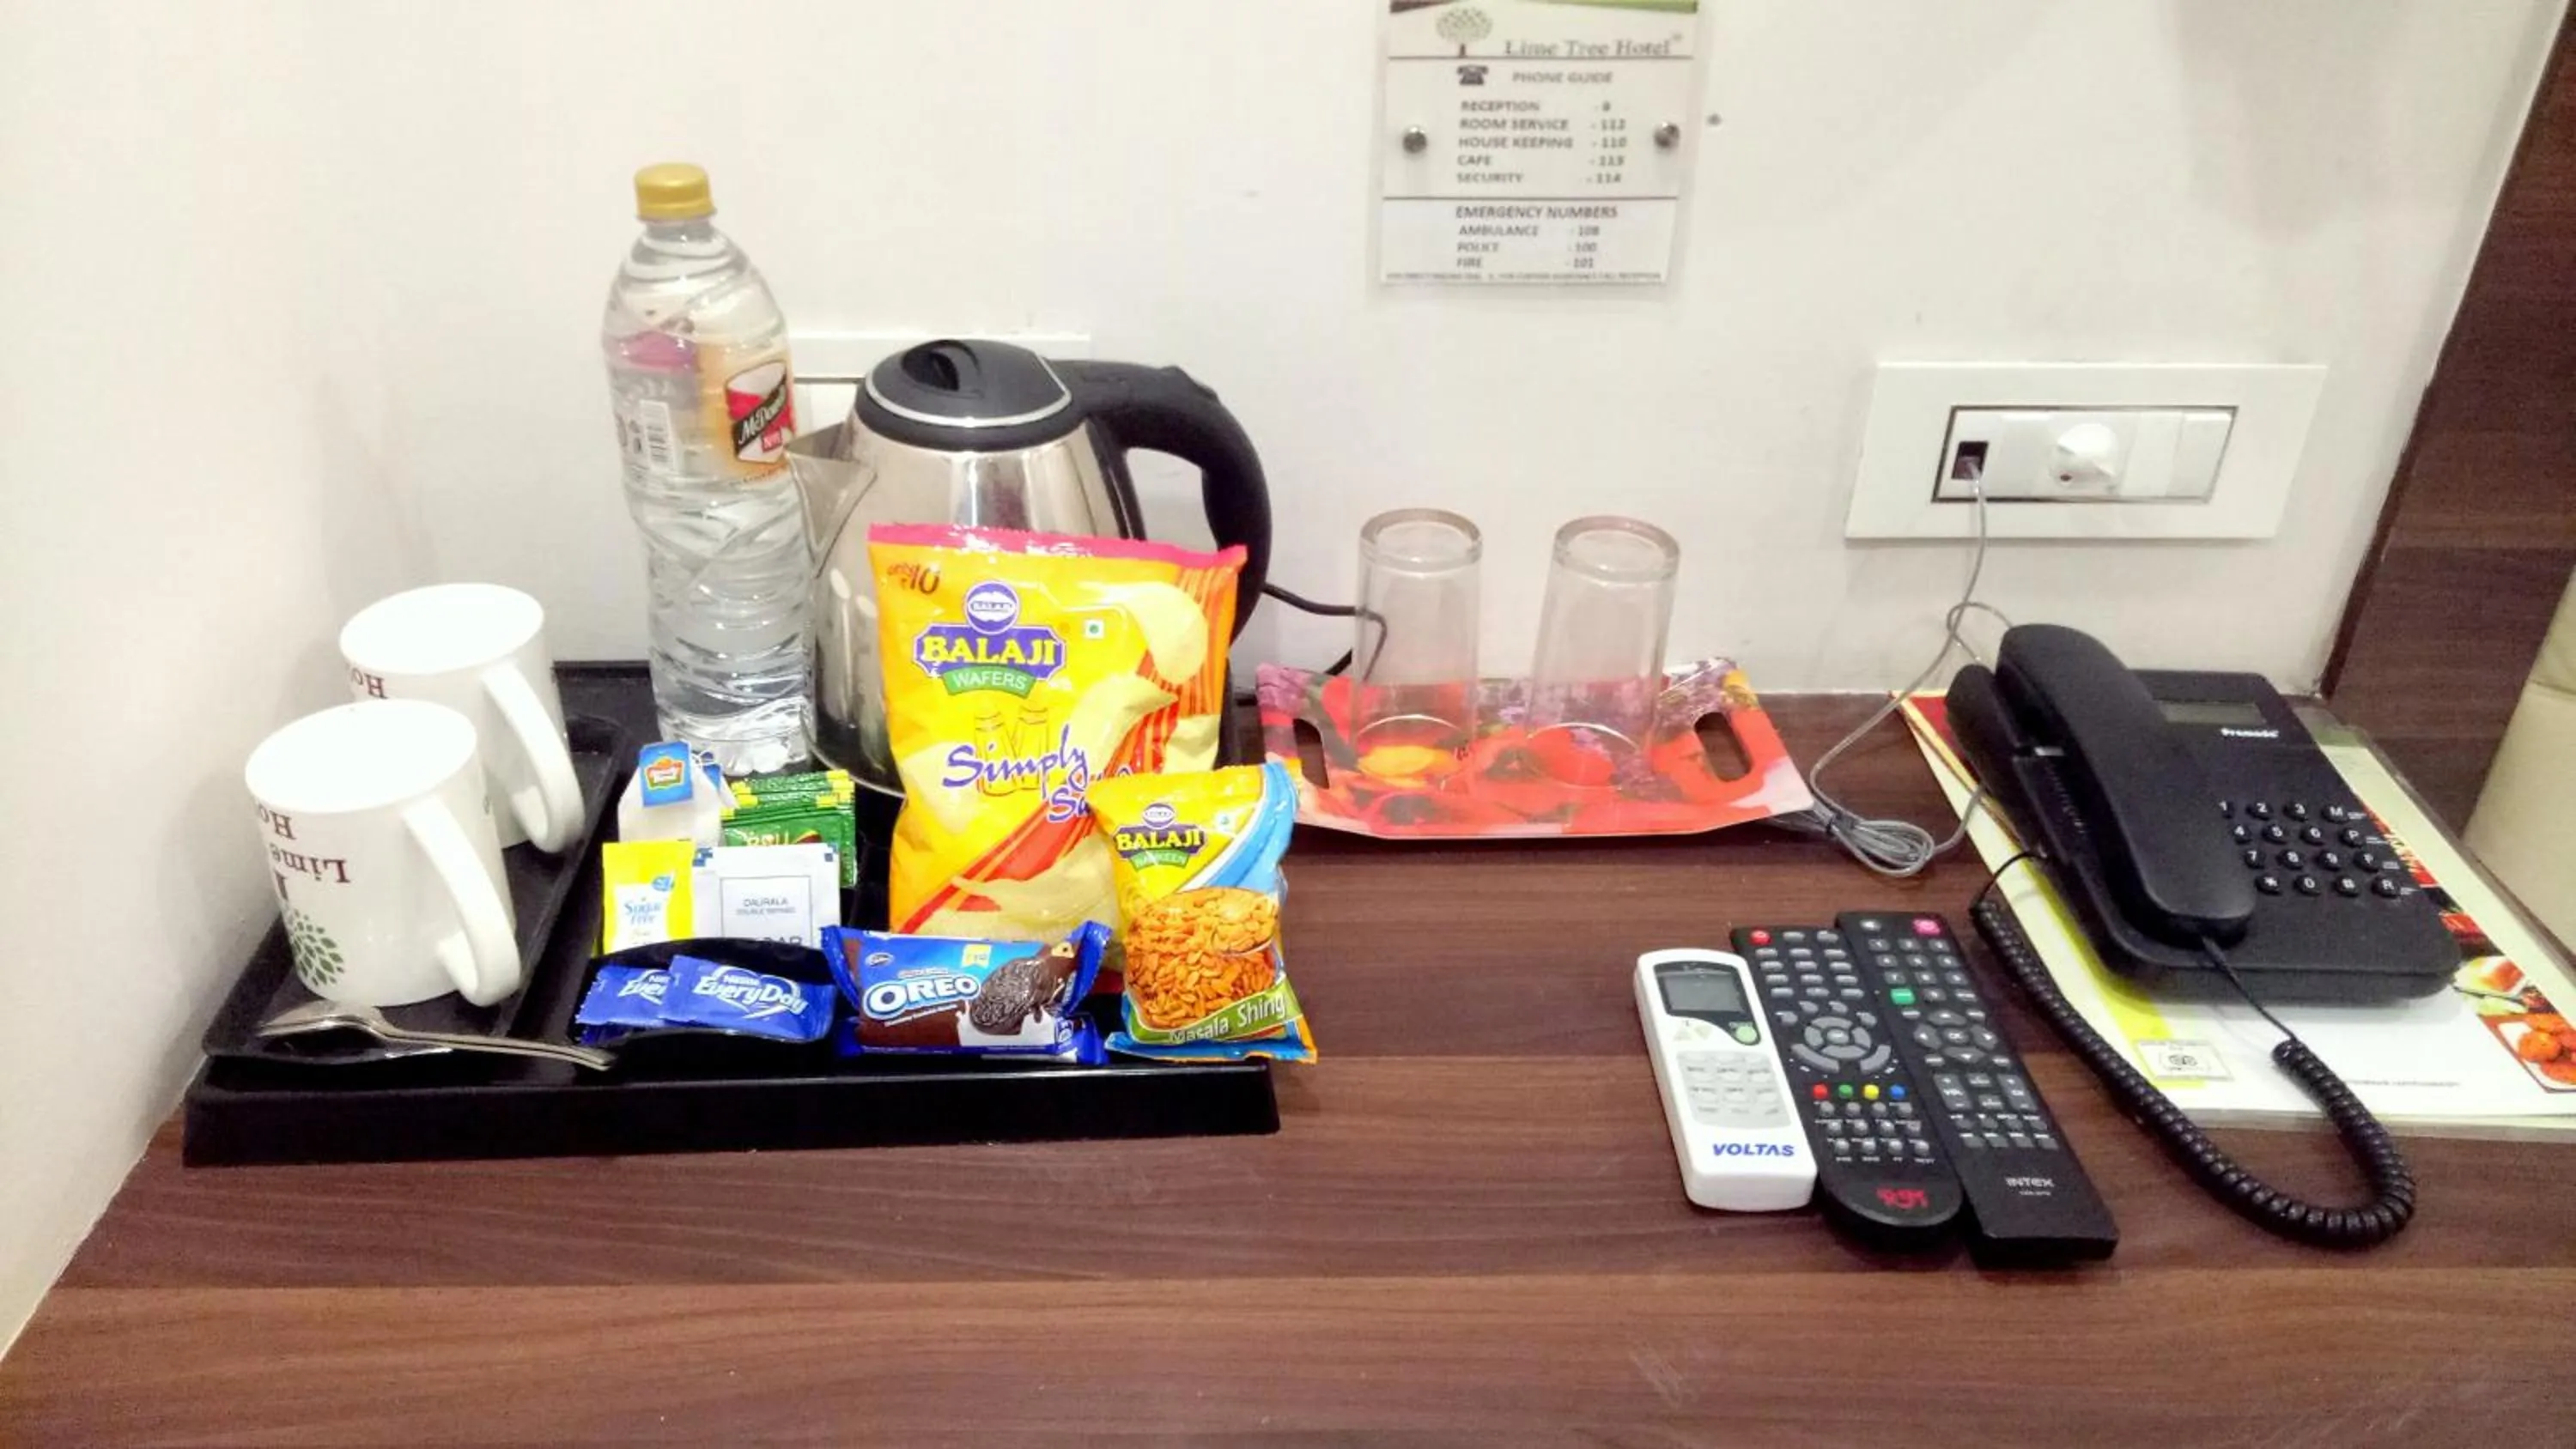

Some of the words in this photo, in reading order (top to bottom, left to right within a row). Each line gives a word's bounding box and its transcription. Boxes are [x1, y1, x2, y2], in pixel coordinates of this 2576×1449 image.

[1504, 39, 1558, 56] Lime
[1566, 39, 1609, 56] Tree
[1616, 39, 1671, 56] Hotel
[1512, 72, 1564, 83] PHONE
[1567, 72, 1613, 84] GUIDE
[1461, 100, 1540, 112] RECEPTION
[1460, 118, 1507, 130] ROOM
[1512, 118, 1570, 130] SERVICE
[1459, 136, 1508, 148] HOUSE
[1512, 136, 1574, 149] KEEPING
[1457, 155, 1492, 167] CAFE
[1456, 173, 1524, 184] SECURITY
[1455, 206, 1543, 218] EMERGENCY
[1546, 206, 1618, 219] NUMBERS
[1459, 225, 1539, 236] AMBULANCE
[921, 634, 1060, 666] BALAJI
[951, 670, 1028, 691] WAFERS
[942, 723, 1091, 801] Simply
[1115, 828, 1200, 852] BALAJI
[270, 842, 350, 883] Lime
[868, 978, 977, 1014] OREO
[1170, 1016, 1230, 1043] Masala
[1236, 992, 1285, 1028] Shing
[1712, 1143, 1795, 1157] VOLTAS
